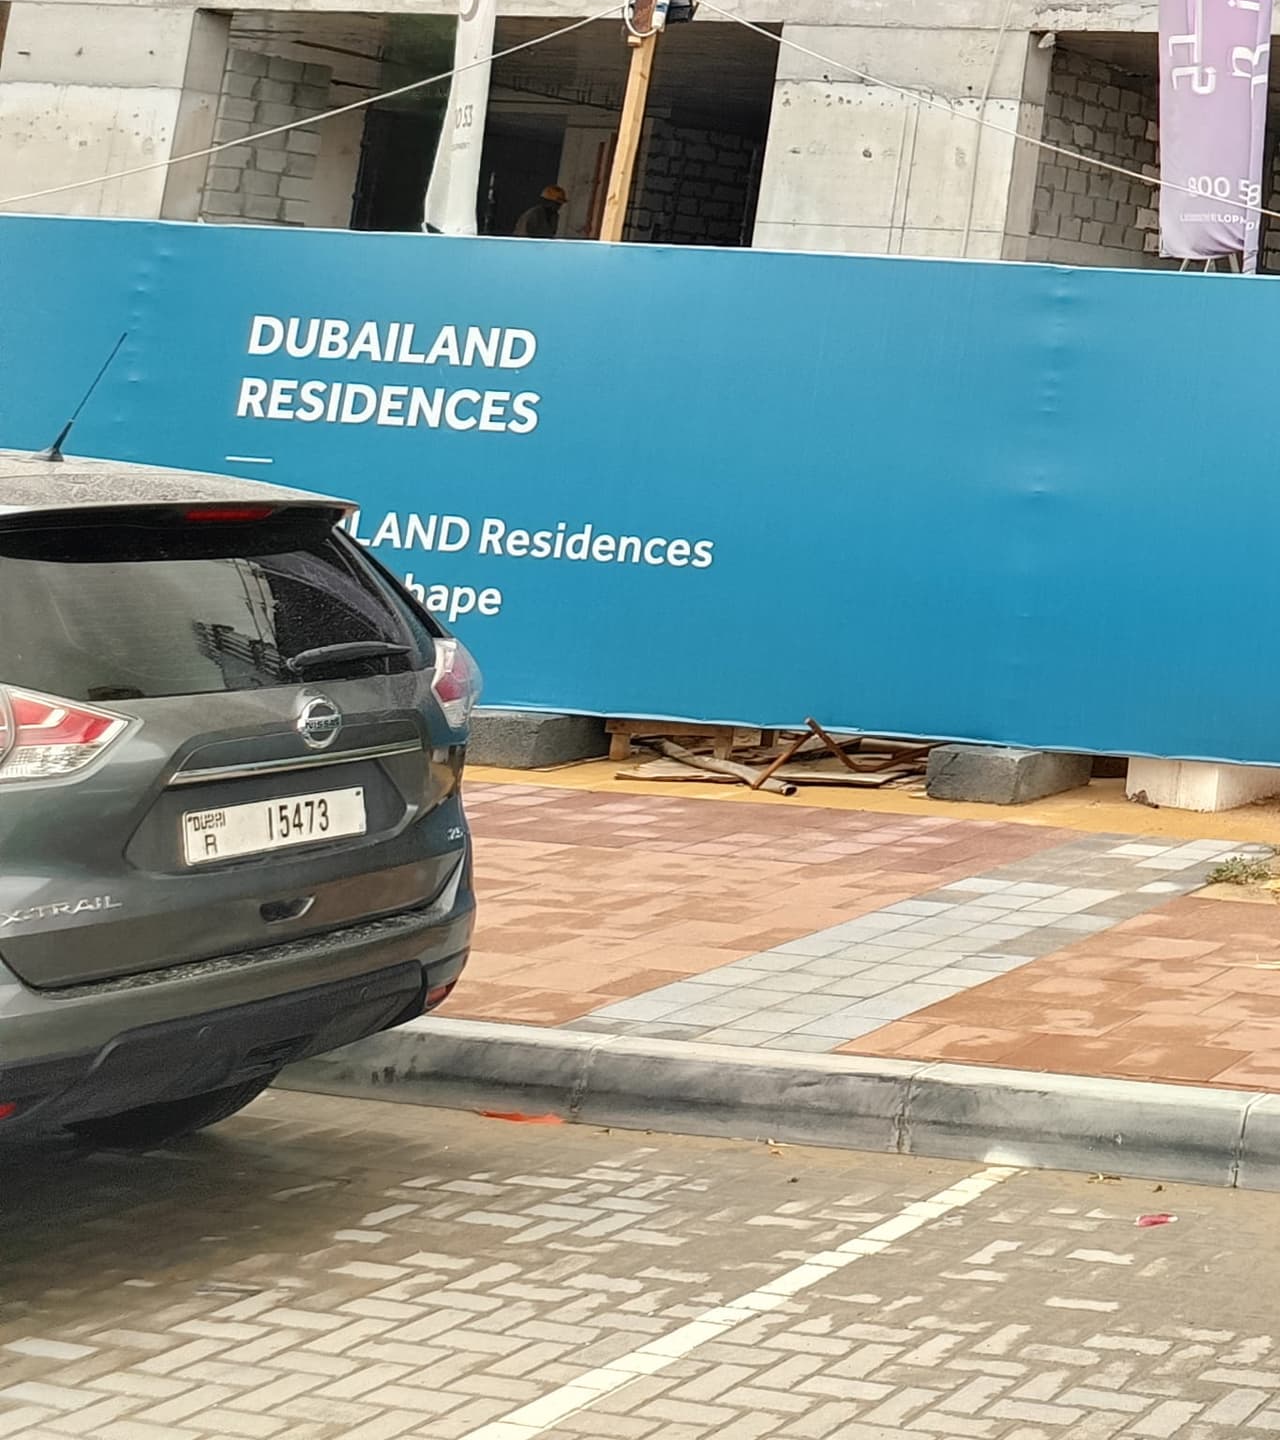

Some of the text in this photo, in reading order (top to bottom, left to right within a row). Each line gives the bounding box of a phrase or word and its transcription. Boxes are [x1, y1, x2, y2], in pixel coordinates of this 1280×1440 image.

[247, 314, 537, 370] DUBAILAND
[236, 377, 541, 434] RESIDENCES
[336, 510, 715, 569] LAND Residences
[404, 572, 503, 623] hape
[267, 798, 330, 841] 15473
